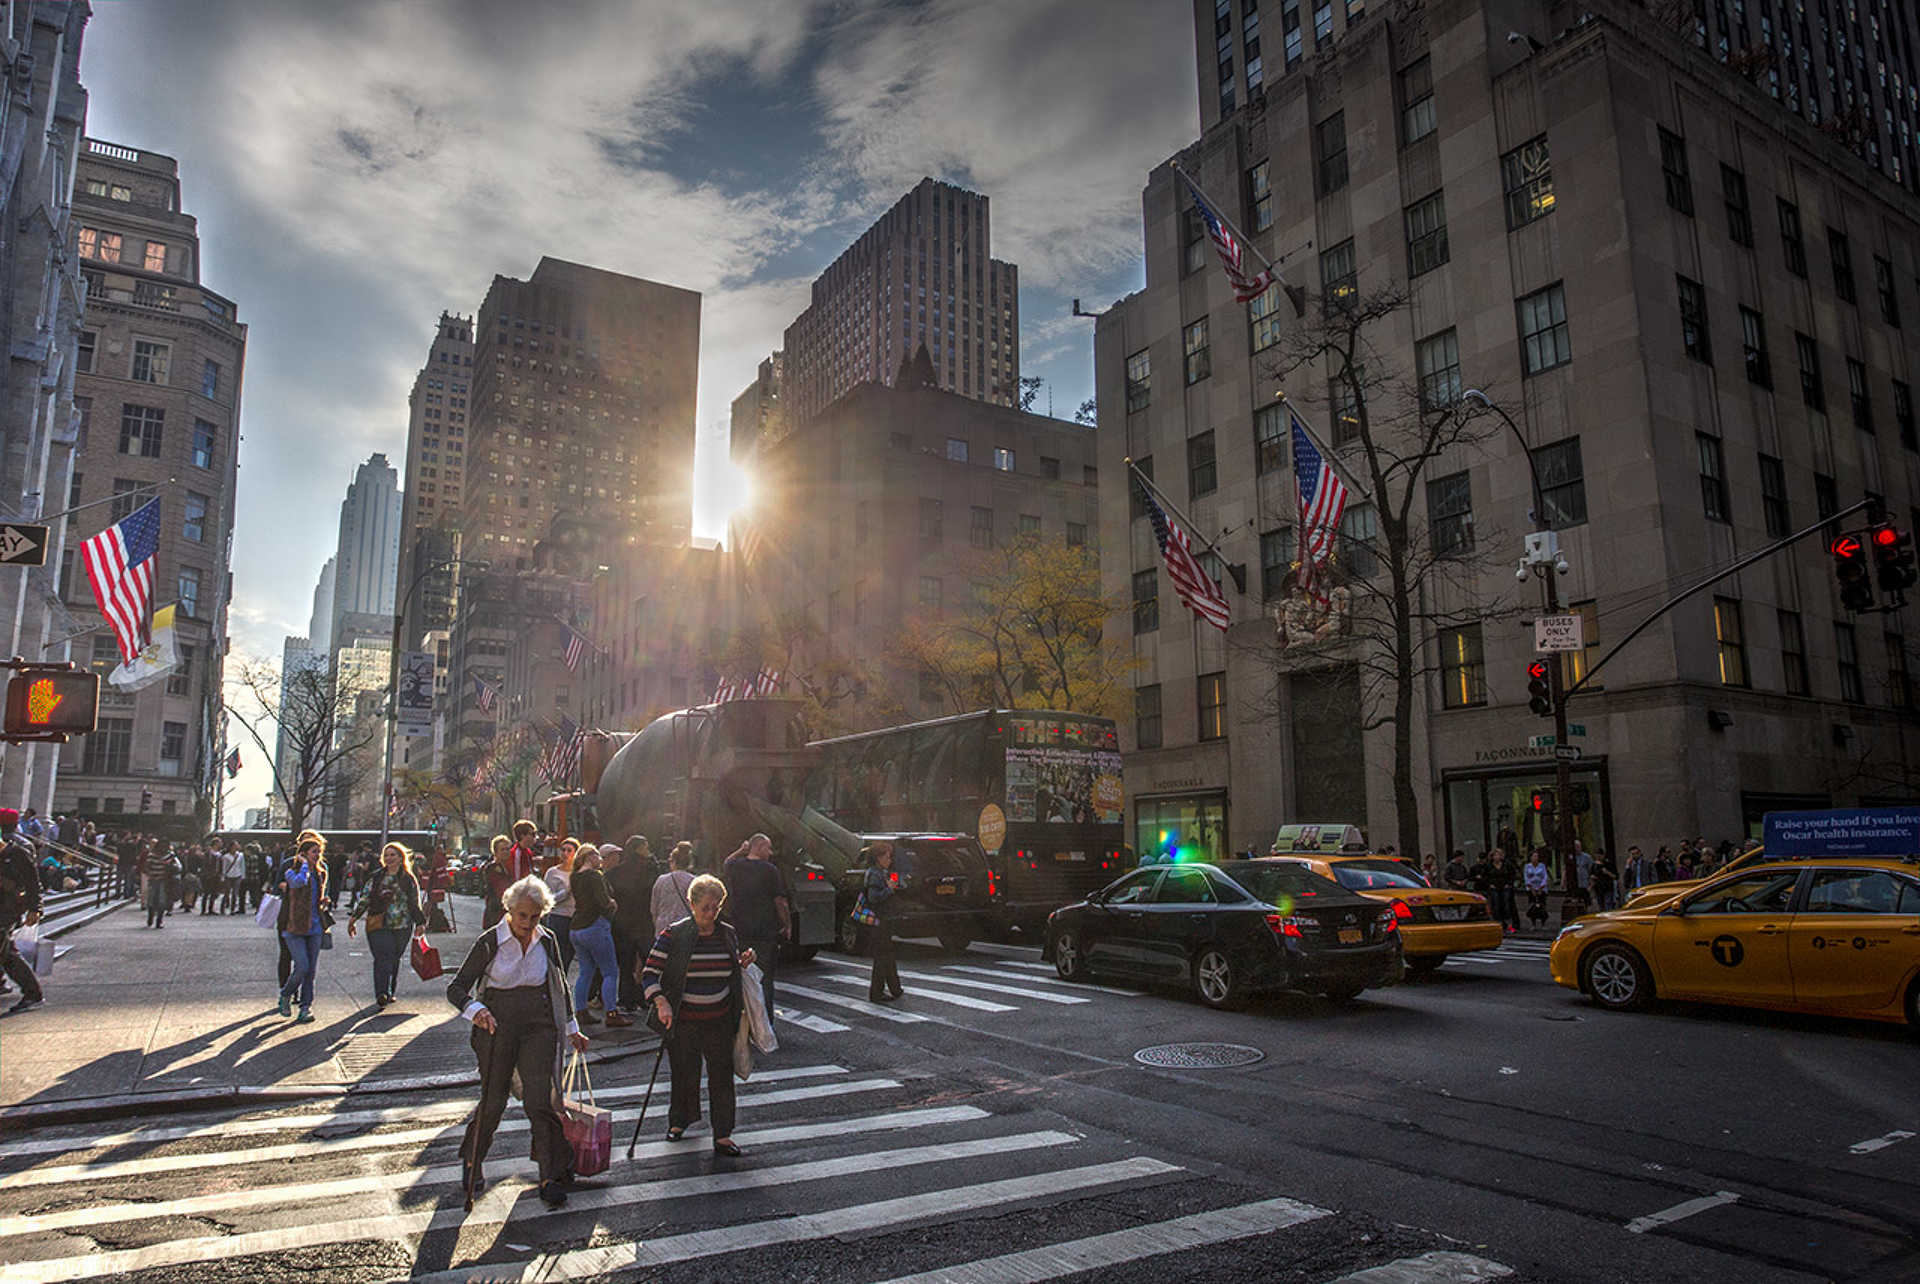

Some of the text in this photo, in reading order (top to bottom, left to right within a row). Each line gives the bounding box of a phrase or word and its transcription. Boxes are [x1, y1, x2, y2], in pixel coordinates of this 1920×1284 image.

[1542, 618, 1574, 627] BUSES
[1546, 627, 1570, 636] ONLY
[1474, 746, 1555, 762] FAÇONNABL
[1775, 818, 1802, 829] Raise
[1803, 818, 1829, 830] your
[1830, 815, 1859, 828] hand
[1861, 814, 1871, 826] if
[1871, 817, 1893, 828] you
[1782, 826, 1912, 841] Oscar health insurance.
